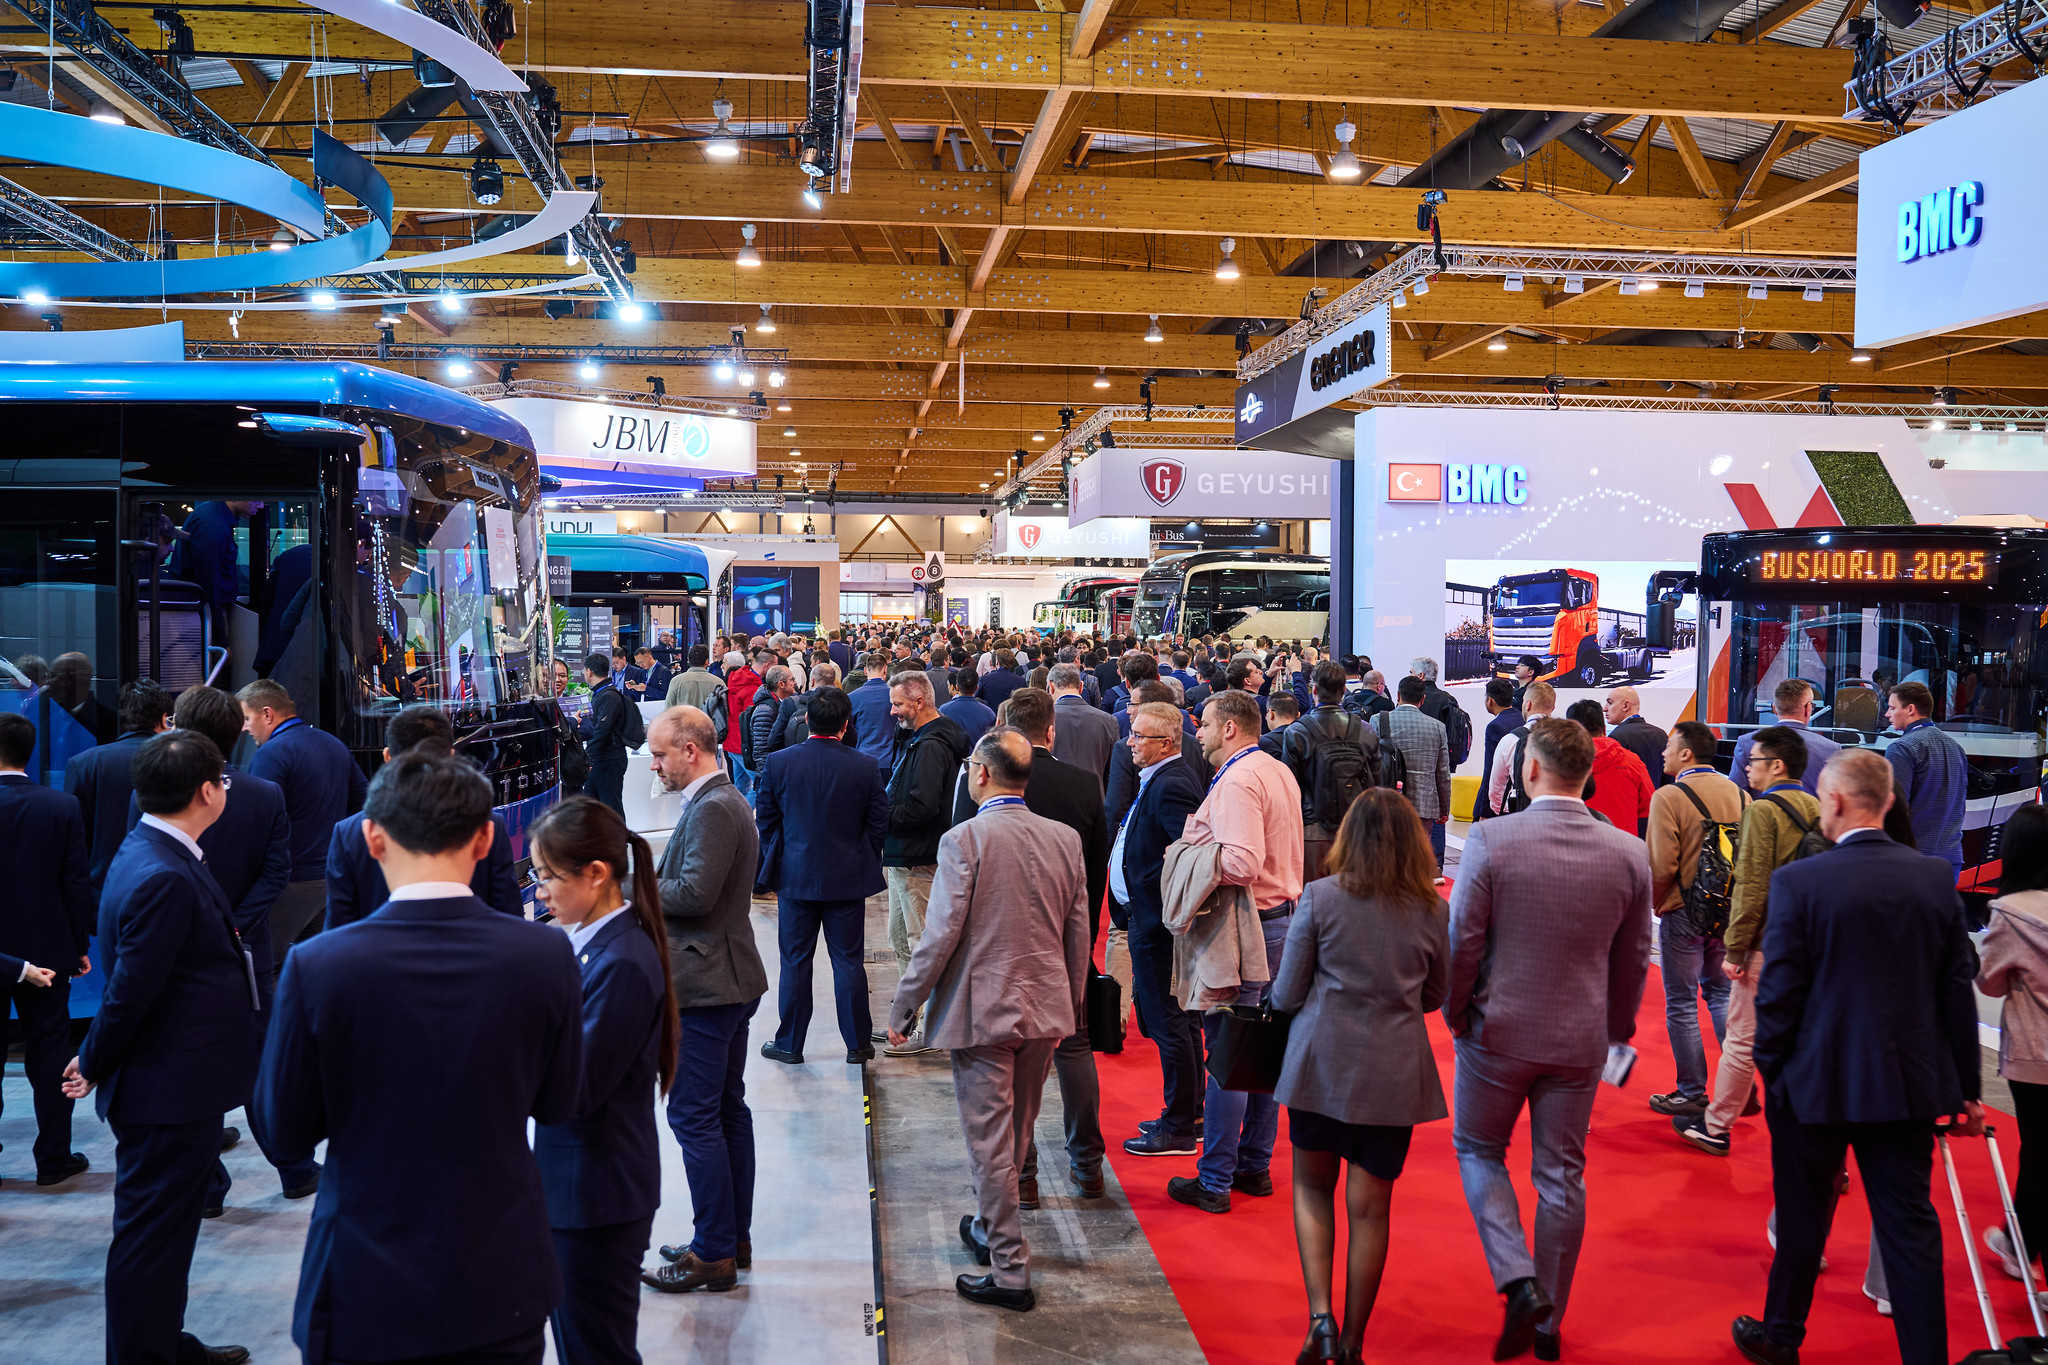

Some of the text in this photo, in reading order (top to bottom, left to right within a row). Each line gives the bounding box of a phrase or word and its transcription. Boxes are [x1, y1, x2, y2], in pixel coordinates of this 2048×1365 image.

[1897, 180, 1984, 264] BMC
[593, 415, 670, 454] JBM
[1197, 472, 1328, 496] GEYUSHI
[1446, 463, 1528, 506] BMC
[1051, 530, 1129, 545] GEYUSHI
[932, 567, 938, 575] 8
[1763, 552, 1984, 580] BUSWORLD 2025
[863, 1303, 874, 1336] MIND THE STEP
